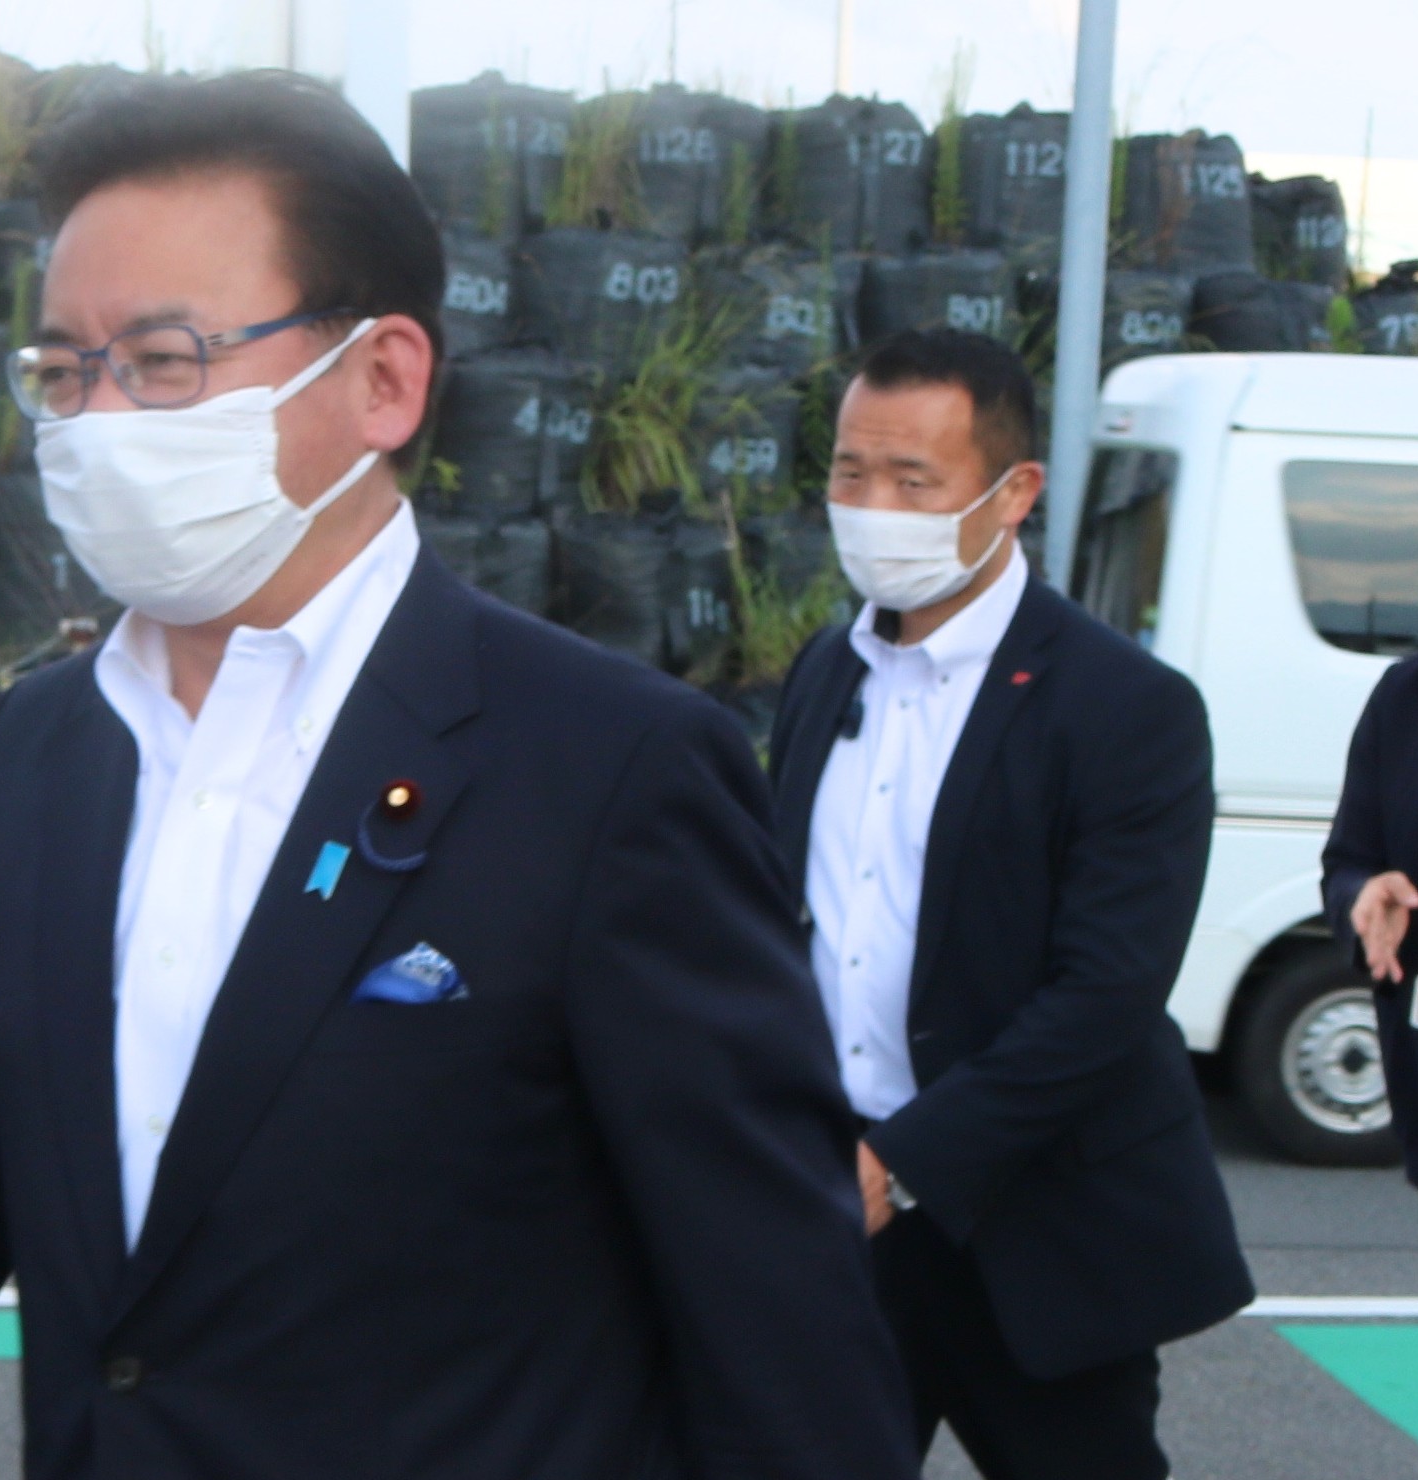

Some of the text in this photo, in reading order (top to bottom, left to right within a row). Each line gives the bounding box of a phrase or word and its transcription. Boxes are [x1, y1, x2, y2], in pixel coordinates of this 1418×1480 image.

[1004, 141, 1068, 178] 112
[605, 261, 678, 304] 803
[945, 294, 1001, 336] 801
